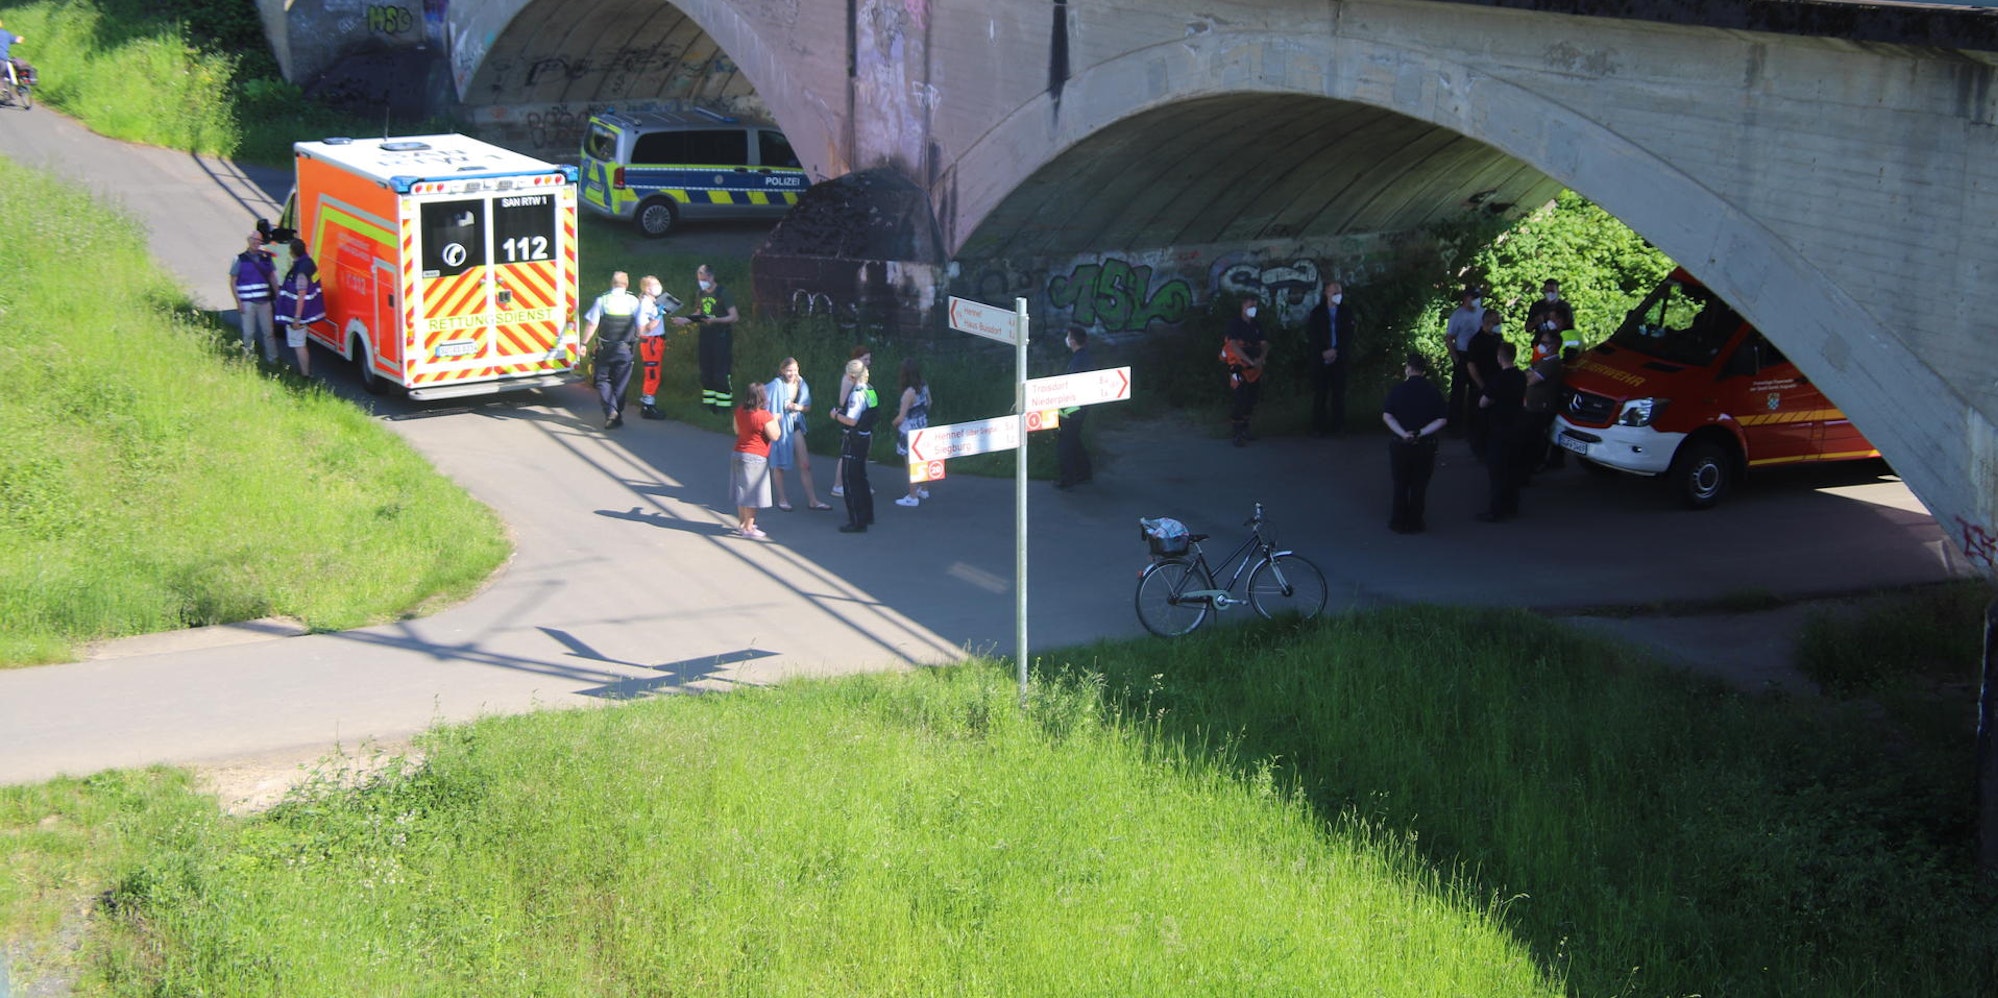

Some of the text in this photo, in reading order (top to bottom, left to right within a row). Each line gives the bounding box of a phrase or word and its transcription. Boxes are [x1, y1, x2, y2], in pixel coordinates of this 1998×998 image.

[765, 176, 800, 186] POLIZEI
[502, 196, 547, 208] SAN RTW 1
[503, 236, 548, 262] 112
[429, 309, 553, 330] RETTUNGSDIENST
[1032, 381, 1068, 393] Troisdorf
[935, 428, 964, 440] Hennef
[935, 442, 972, 456] Siegburg
[930, 465, 942, 474] 20
